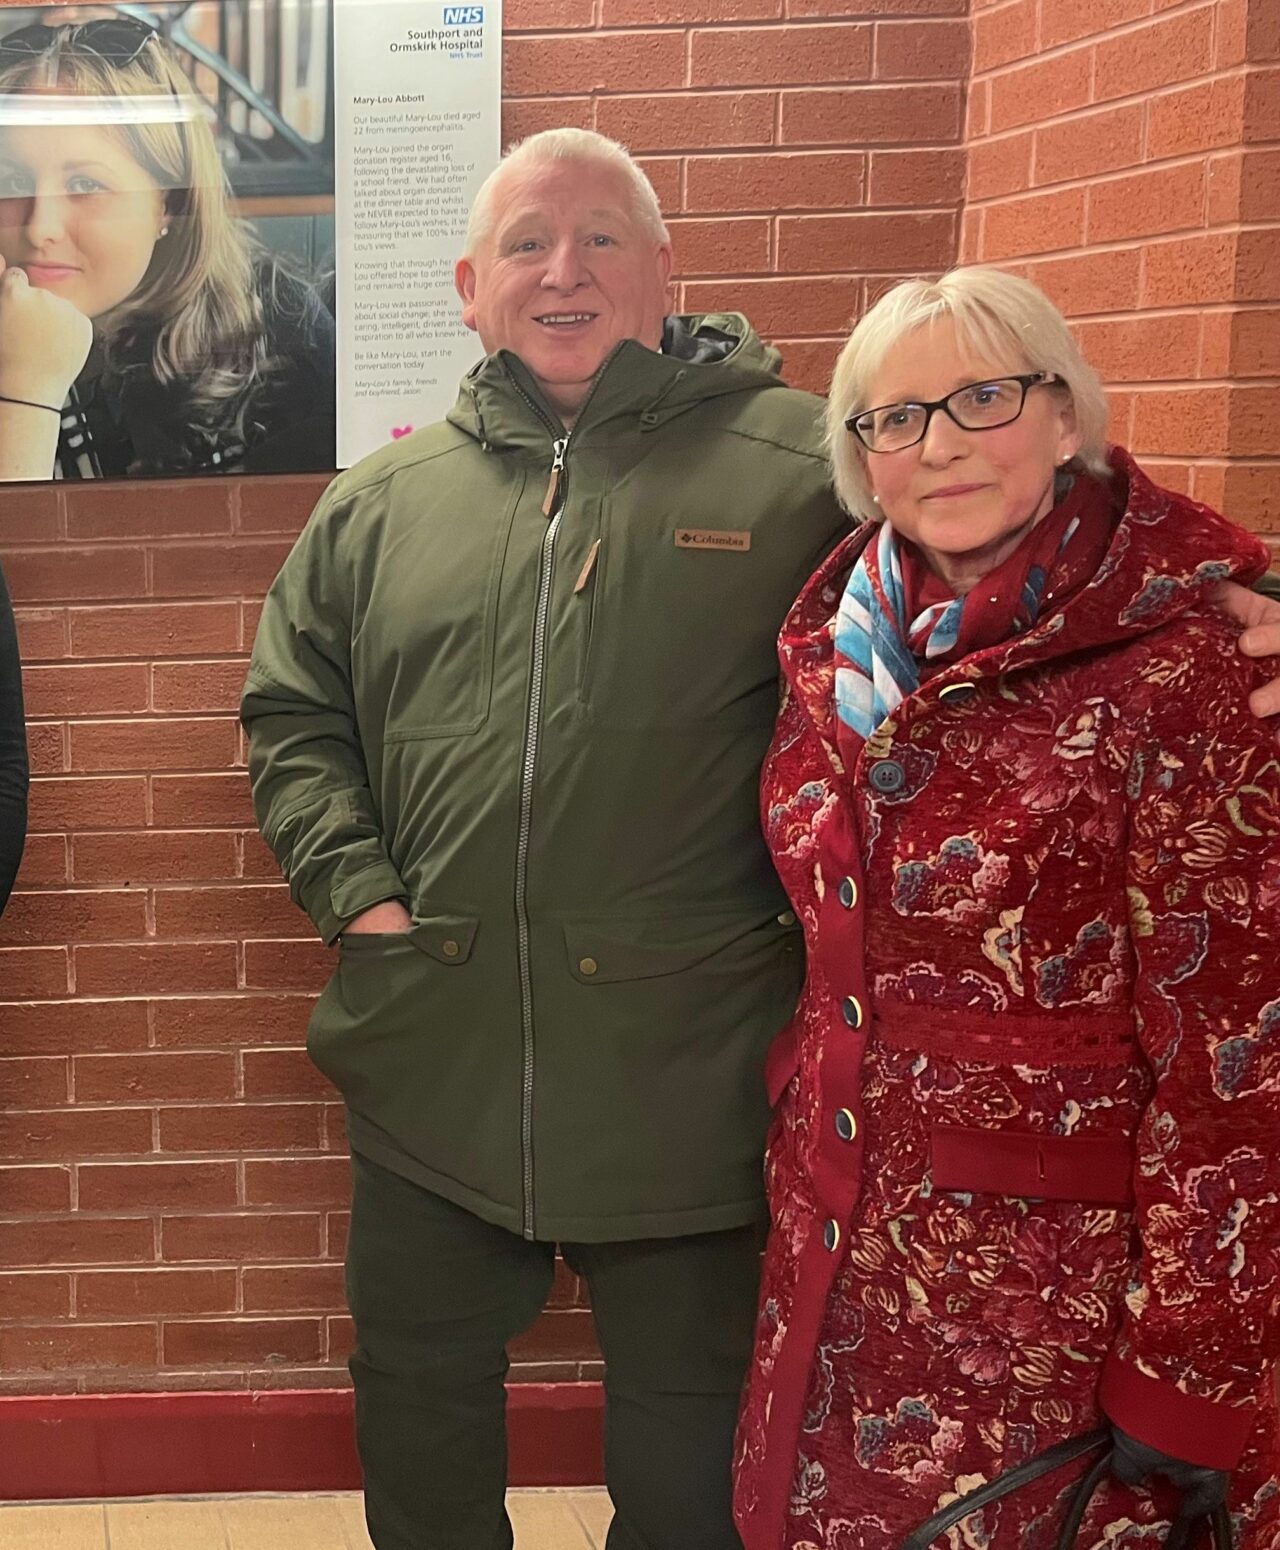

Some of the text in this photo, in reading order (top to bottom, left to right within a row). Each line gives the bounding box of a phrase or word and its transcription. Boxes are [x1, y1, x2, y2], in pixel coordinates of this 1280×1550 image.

[444, 7, 483, 24] NHS
[407, 27, 483, 41] Southport and
[389, 39, 483, 53] Ormskirk Hospital
[353, 94, 425, 106] Mary-Lou Abbott
[353, 111, 481, 124] Our beautiful Mary-Lou died aged
[353, 126, 364, 135] 22
[366, 126, 384, 135] from
[353, 144, 454, 155] Mary-Lou joined the organ
[353, 156, 388, 165] donation
[390, 155, 418, 165] register
[420, 154, 439, 164] aged
[353, 163, 475, 177] following the devastating loss of
[361, 178, 385, 187] school
[416, 176, 429, 184] We
[431, 175, 445, 184] had
[447, 174, 468, 183] often
[353, 186, 462, 197] talked about organ donation
[364, 199, 376, 208] the
[378, 198, 402, 207] dinner
[404, 198, 423, 206] table
[425, 197, 440, 205] and
[368, 209, 393, 218] NEVER
[395, 208, 429, 219] expected
[430, 208, 439, 216] to
[441, 207, 459, 215] have
[461, 207, 469, 215] to
[354, 221, 378, 230] follow
[380, 218, 420, 229] Mary-Lou's
[394, 230, 409, 239] that
[426, 229, 448, 237] 100%
[354, 261, 388, 271] Knowing
[390, 260, 405, 268] that
[408, 259, 438, 269] through
[354, 272, 368, 281] Lou
[370, 271, 398, 280] offered
[400, 270, 419, 280] hope
[420, 270, 429, 278] to
[413, 281, 433, 291] huge
[354, 302, 390, 311] Mary-Lou
[409, 299, 448, 310] passionate
[354, 312, 376, 321] about
[379, 311, 400, 320] social
[433, 309, 446, 317] she
[423, 319, 447, 328] driven
[354, 332, 393, 343] inspiration
[395, 331, 404, 340] to
[405, 331, 414, 339] all
[416, 330, 433, 339] who
[435, 329, 455, 338] knew
[366, 351, 379, 360] like
[421, 350, 437, 358] start
[440, 349, 453, 357] the
[354, 361, 401, 371] conversation
[692, 534, 744, 547] Columbia
